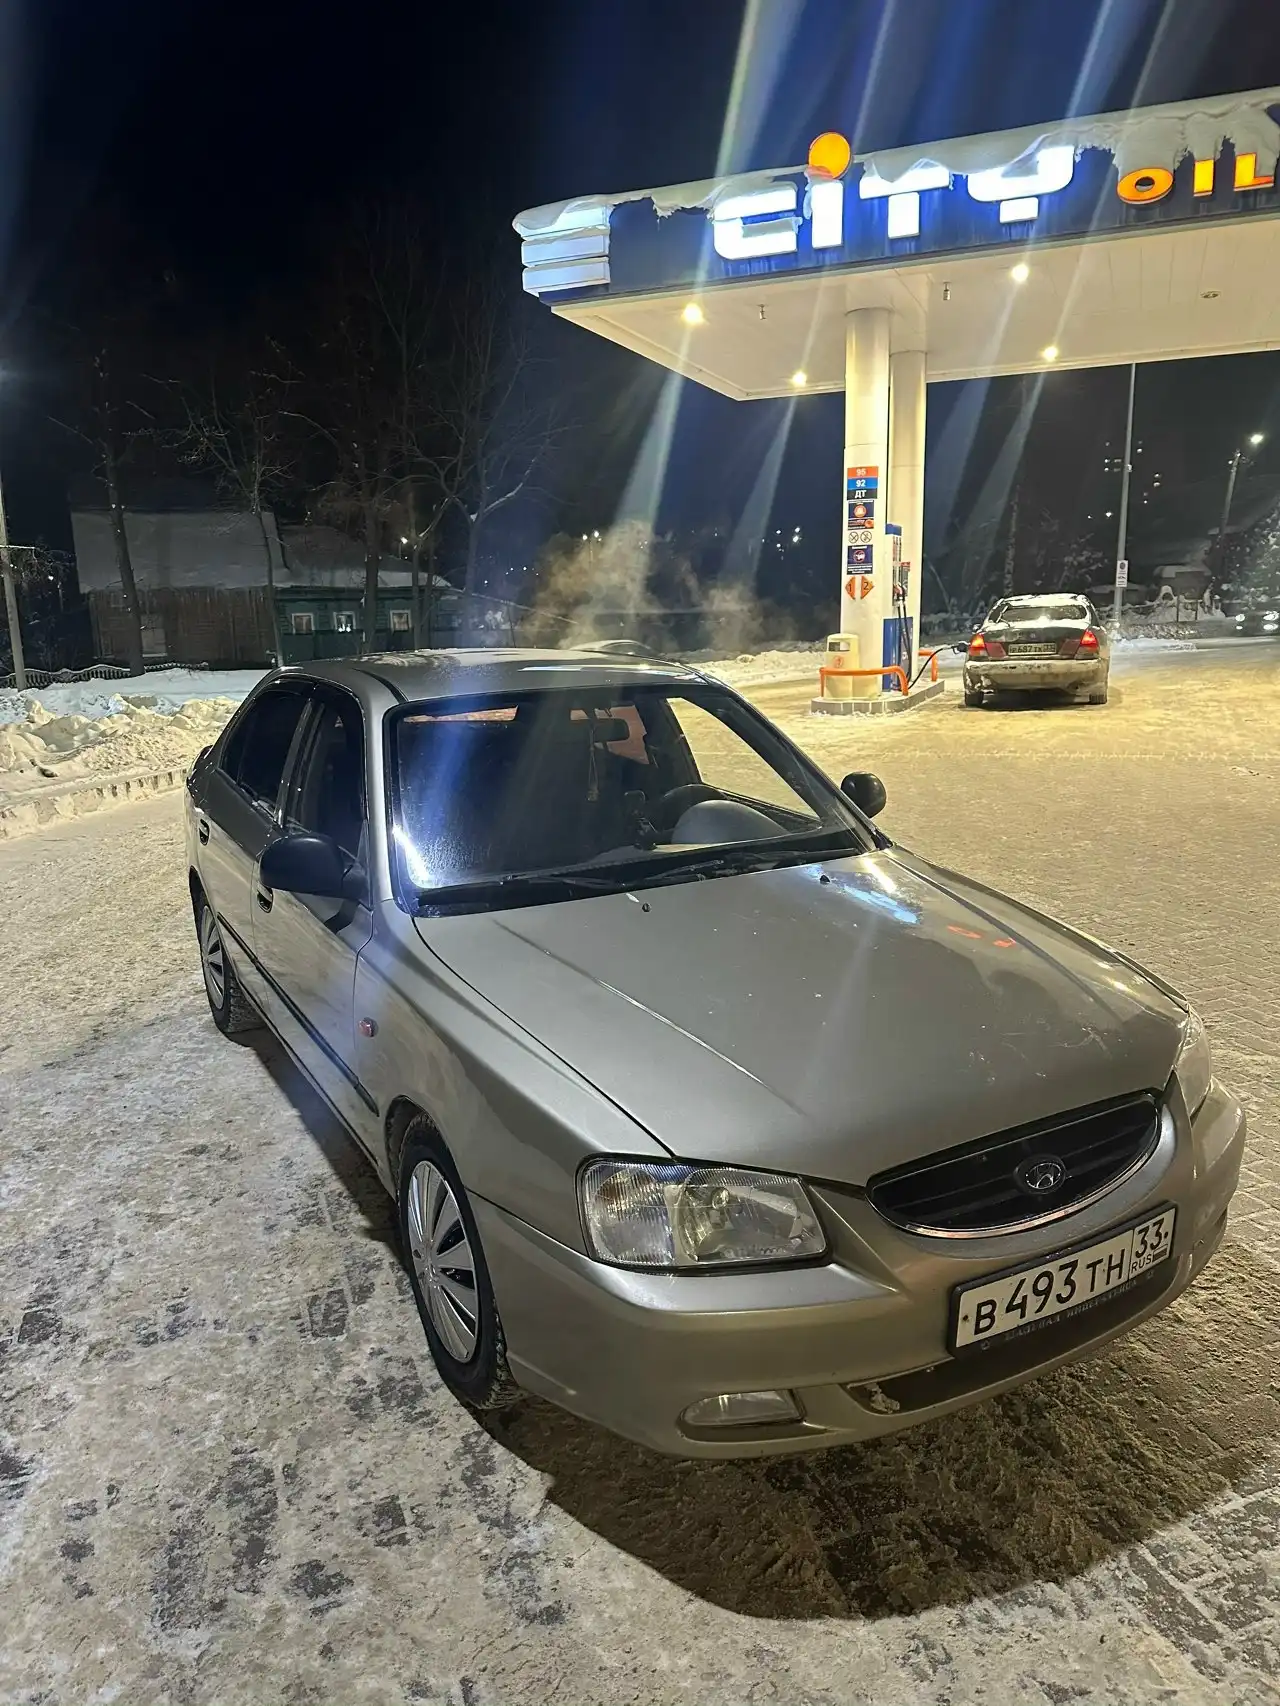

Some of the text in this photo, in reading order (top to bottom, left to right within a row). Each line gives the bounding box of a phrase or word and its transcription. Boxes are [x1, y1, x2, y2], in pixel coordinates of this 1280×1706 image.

[1117, 152, 1275, 205] OIL
[856, 468, 867, 477] 95
[855, 479, 867, 488] 92
[855, 489, 867, 499] ДТ
[1135, 1217, 1166, 1259] 33
[1131, 1254, 1153, 1274] RUS
